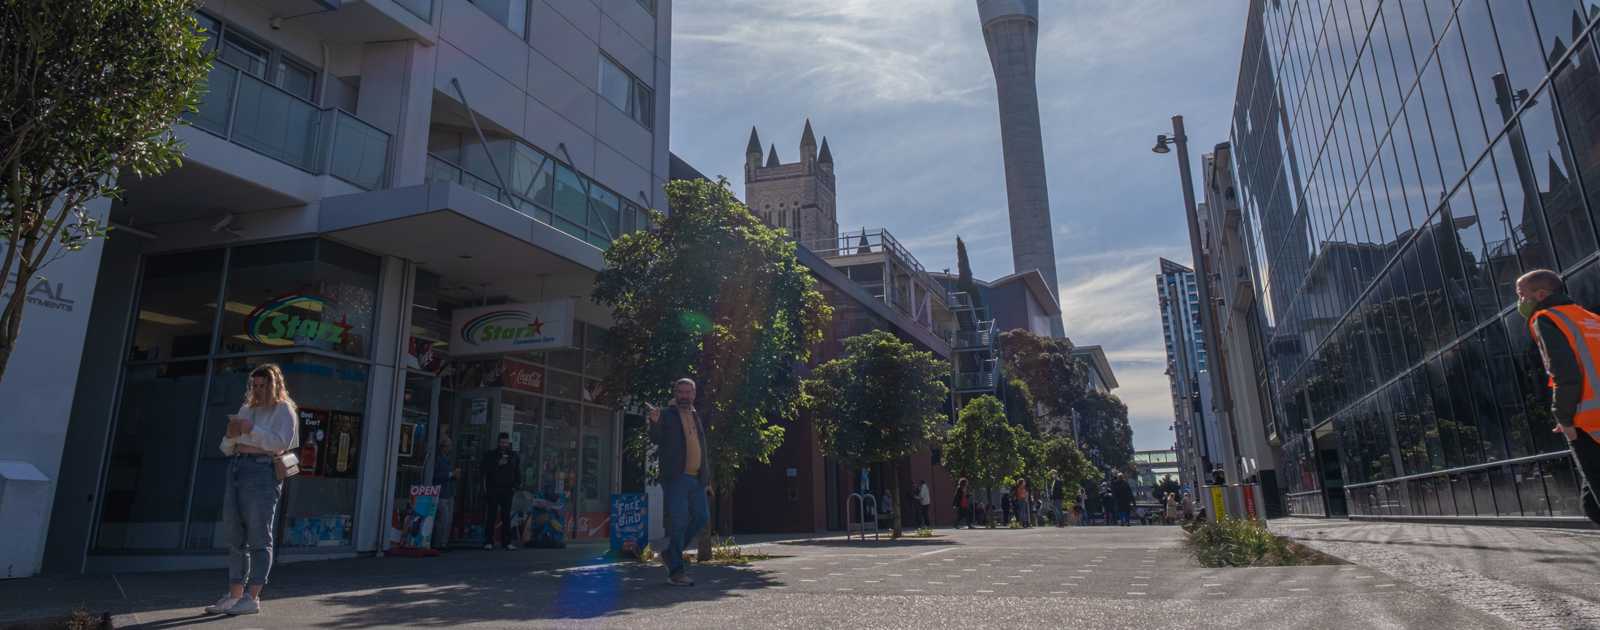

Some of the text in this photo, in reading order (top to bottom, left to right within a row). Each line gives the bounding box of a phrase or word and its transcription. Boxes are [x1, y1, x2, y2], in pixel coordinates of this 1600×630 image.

[268, 314, 343, 344] Starz
[479, 324, 533, 341] Starz
[410, 485, 441, 496] OPEN
